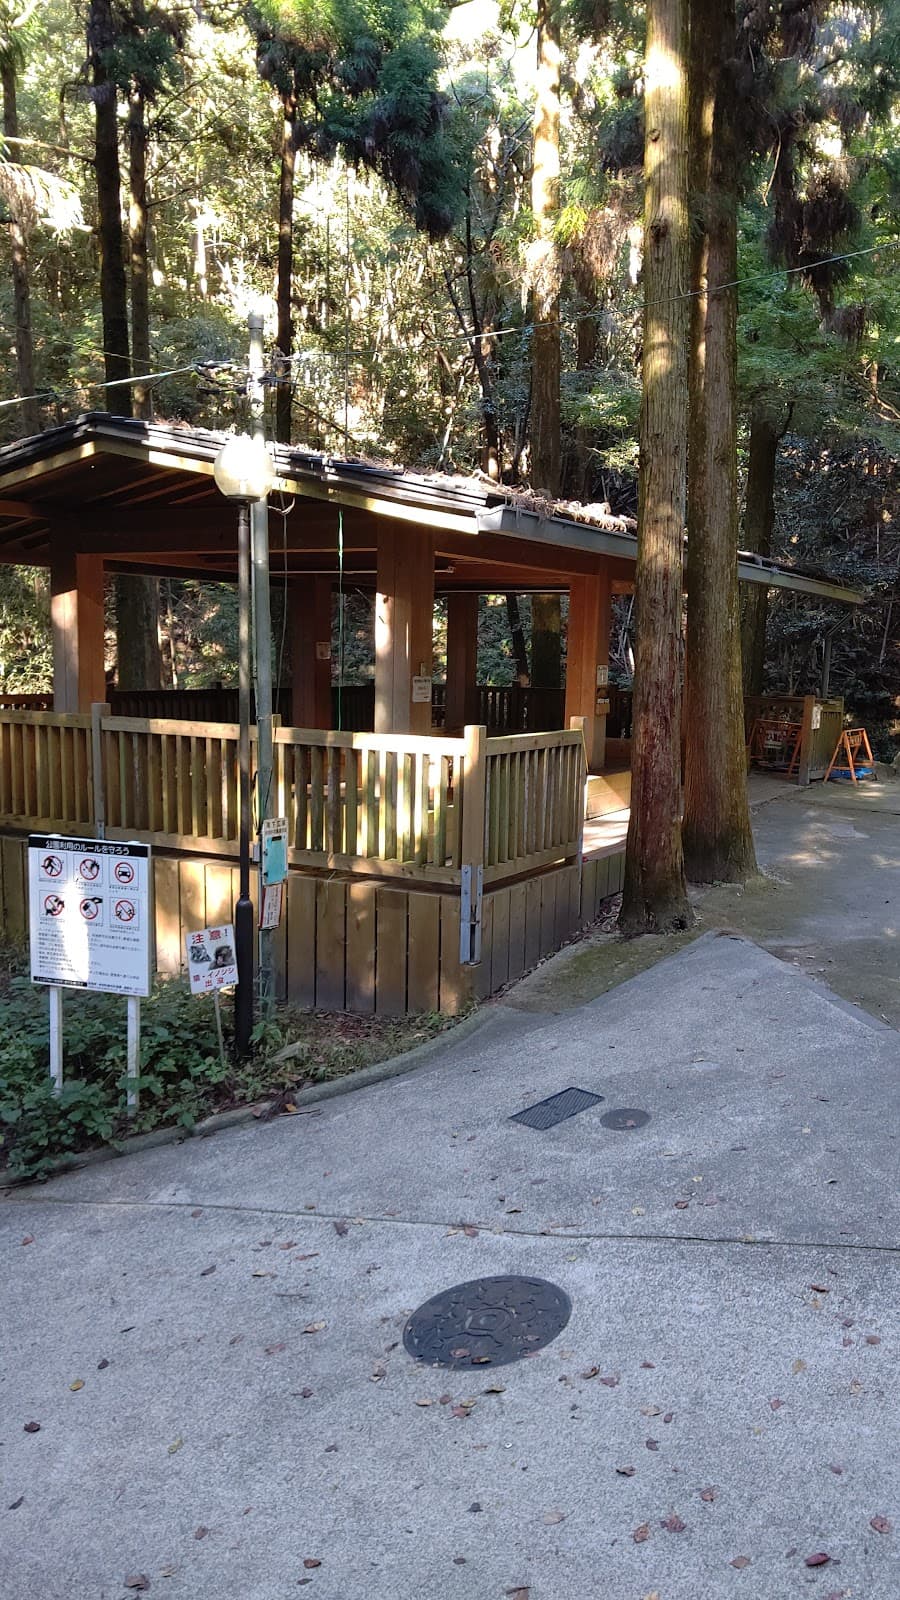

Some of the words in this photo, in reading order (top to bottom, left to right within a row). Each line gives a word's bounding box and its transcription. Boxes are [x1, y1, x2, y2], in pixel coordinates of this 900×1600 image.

[45, 840, 130, 856] 公園利用のルールを守ろう
